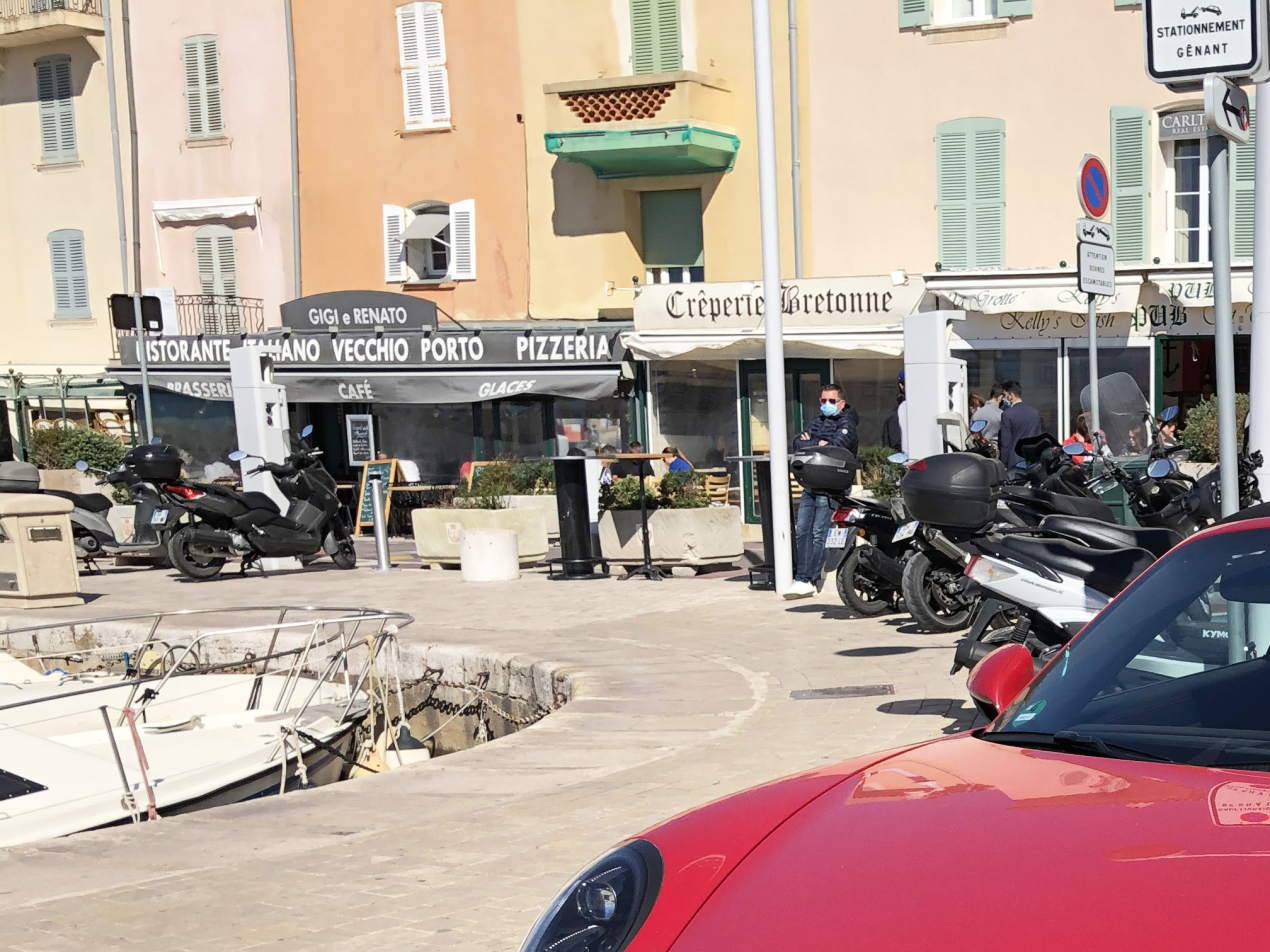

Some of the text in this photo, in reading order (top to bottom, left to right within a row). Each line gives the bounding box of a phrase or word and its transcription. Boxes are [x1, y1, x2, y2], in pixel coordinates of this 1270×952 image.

[1157, 19, 1246, 38] STATIONNEMENT
[1176, 43, 1229, 58] GÊNANT
[1162, 113, 1206, 129] CARLT
[1172, 126, 1190, 134] REAL
[1087, 251, 1108, 260] ATTENTION
[666, 284, 893, 322] Crêperie Bretonne
[308, 306, 408, 326] GIGI e RENATO
[332, 337, 409, 362] VECCHIO
[421, 336, 484, 361] PORTO
[516, 334, 610, 361] PIZZERIA
[338, 379, 374, 400] CAFÉ
[478, 379, 537, 398] GLACES
